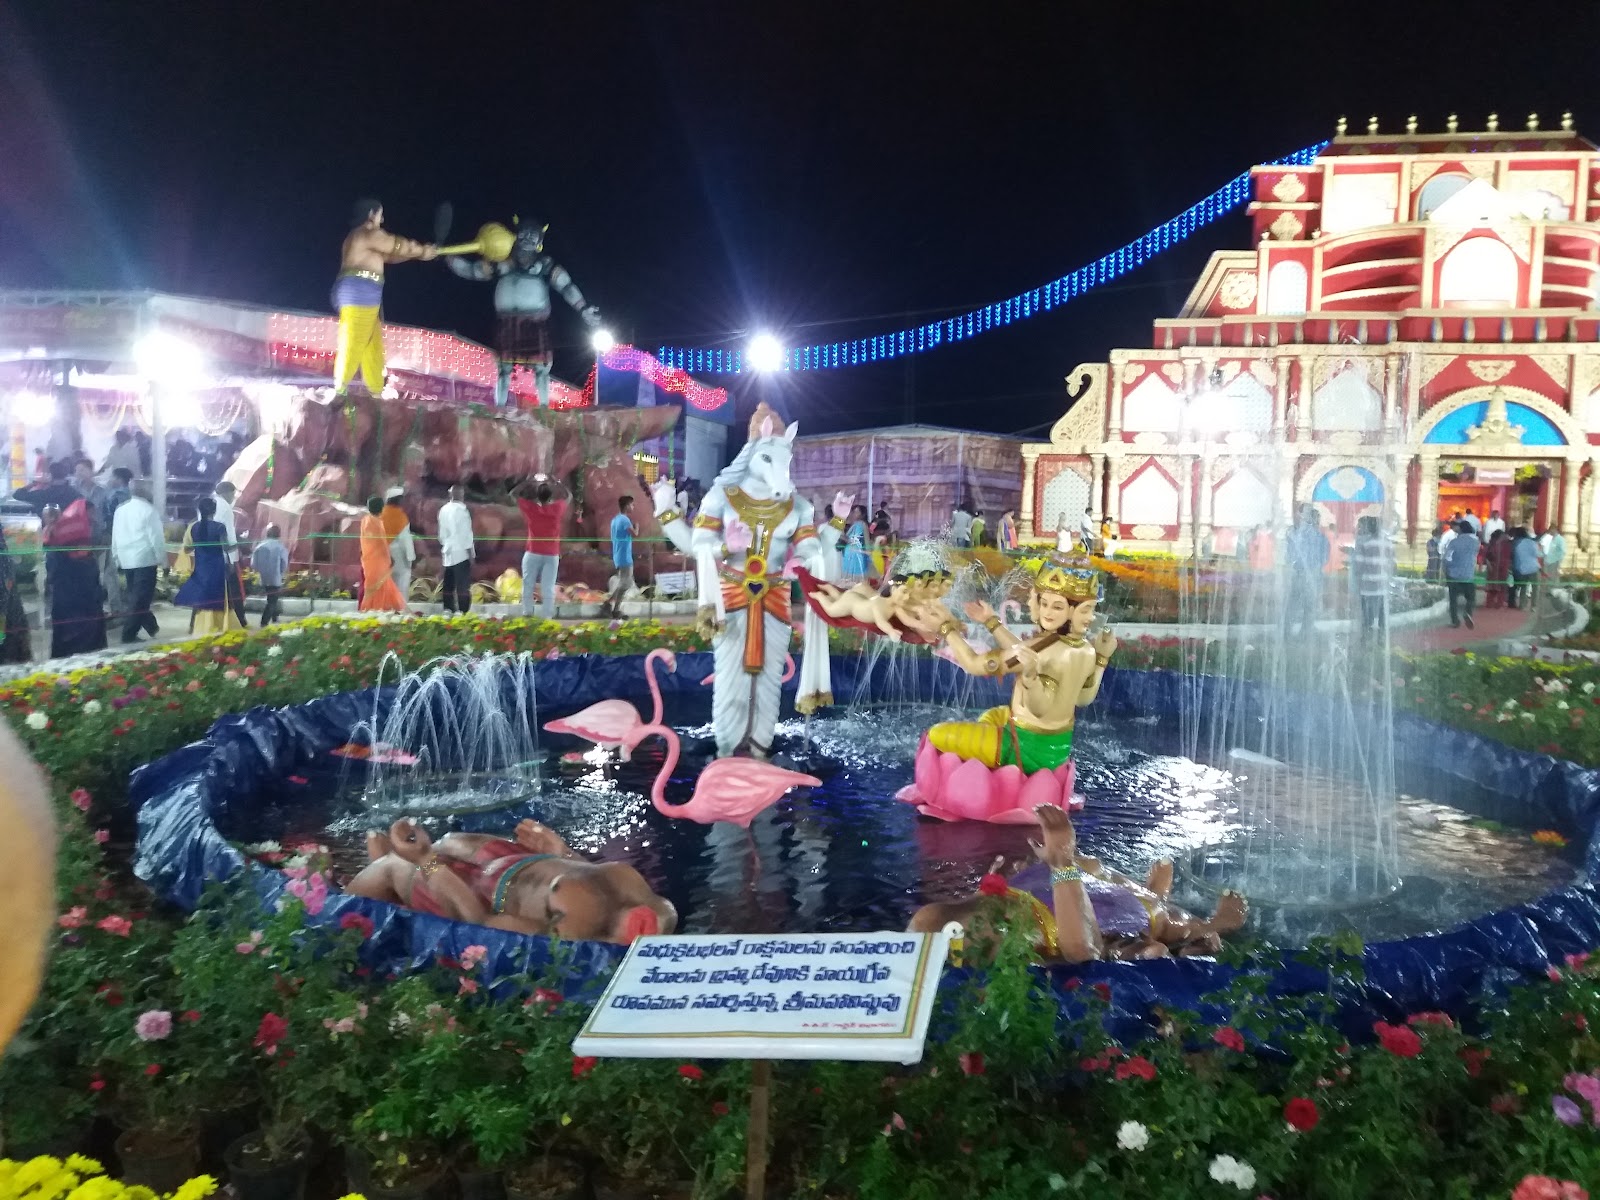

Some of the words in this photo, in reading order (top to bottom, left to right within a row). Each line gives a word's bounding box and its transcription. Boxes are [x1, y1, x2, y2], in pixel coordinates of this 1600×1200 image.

[743, 940, 826, 958] రాక్షసులను
[829, 940, 916, 955] సంహరించి
[640, 966, 706, 984] వేదాలను
